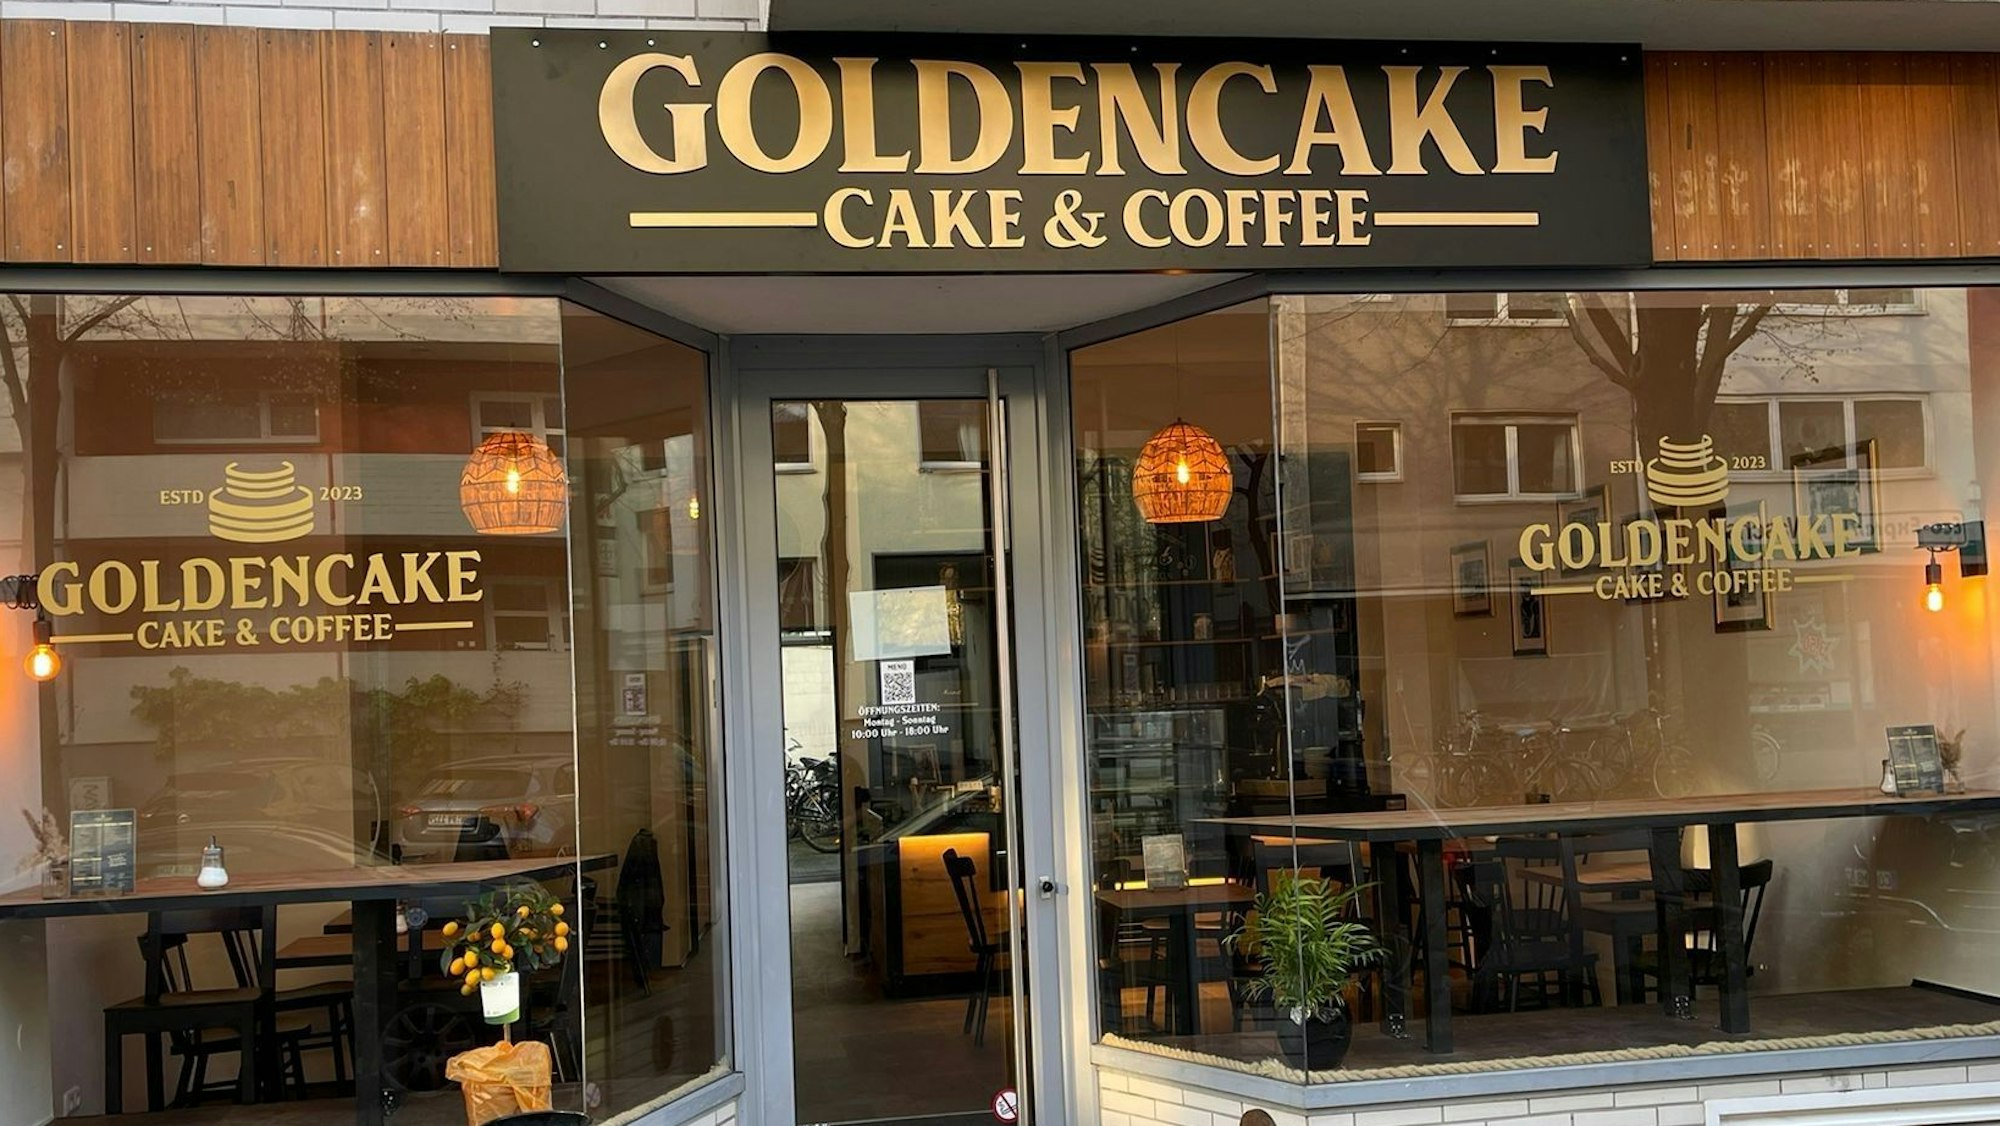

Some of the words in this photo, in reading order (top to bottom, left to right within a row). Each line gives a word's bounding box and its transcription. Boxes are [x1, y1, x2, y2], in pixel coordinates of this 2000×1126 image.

[598, 52, 1556, 176] GOLDENCAKE
[823, 187, 1024, 249] CAKE
[1043, 190, 1104, 248] &
[1122, 188, 1371, 248] COFFEE
[1609, 460, 1644, 474] ESTD
[1732, 456, 1766, 469] 2023
[159, 489, 204, 504] ESTD
[319, 486, 363, 501] 2023
[1518, 512, 1861, 571] GOLDENCAKE
[36, 549, 483, 616] GOLDENCAKE
[1595, 574, 1664, 600] CAKE
[1671, 573, 1690, 597] &
[1697, 569, 1793, 595] COFFEE
[136, 618, 226, 650] CAKE
[235, 617, 260, 646] &
[269, 613, 393, 645] COFFEE
[858, 703, 940, 717] ÖFFNUNGSZEITEN:
[863, 718, 895, 728] Montag
[902, 715, 937, 726] Sonntag
[851, 729, 879, 739] 10:00
[881, 728, 898, 737] Uhr
[932, 725, 949, 734] Uhr
